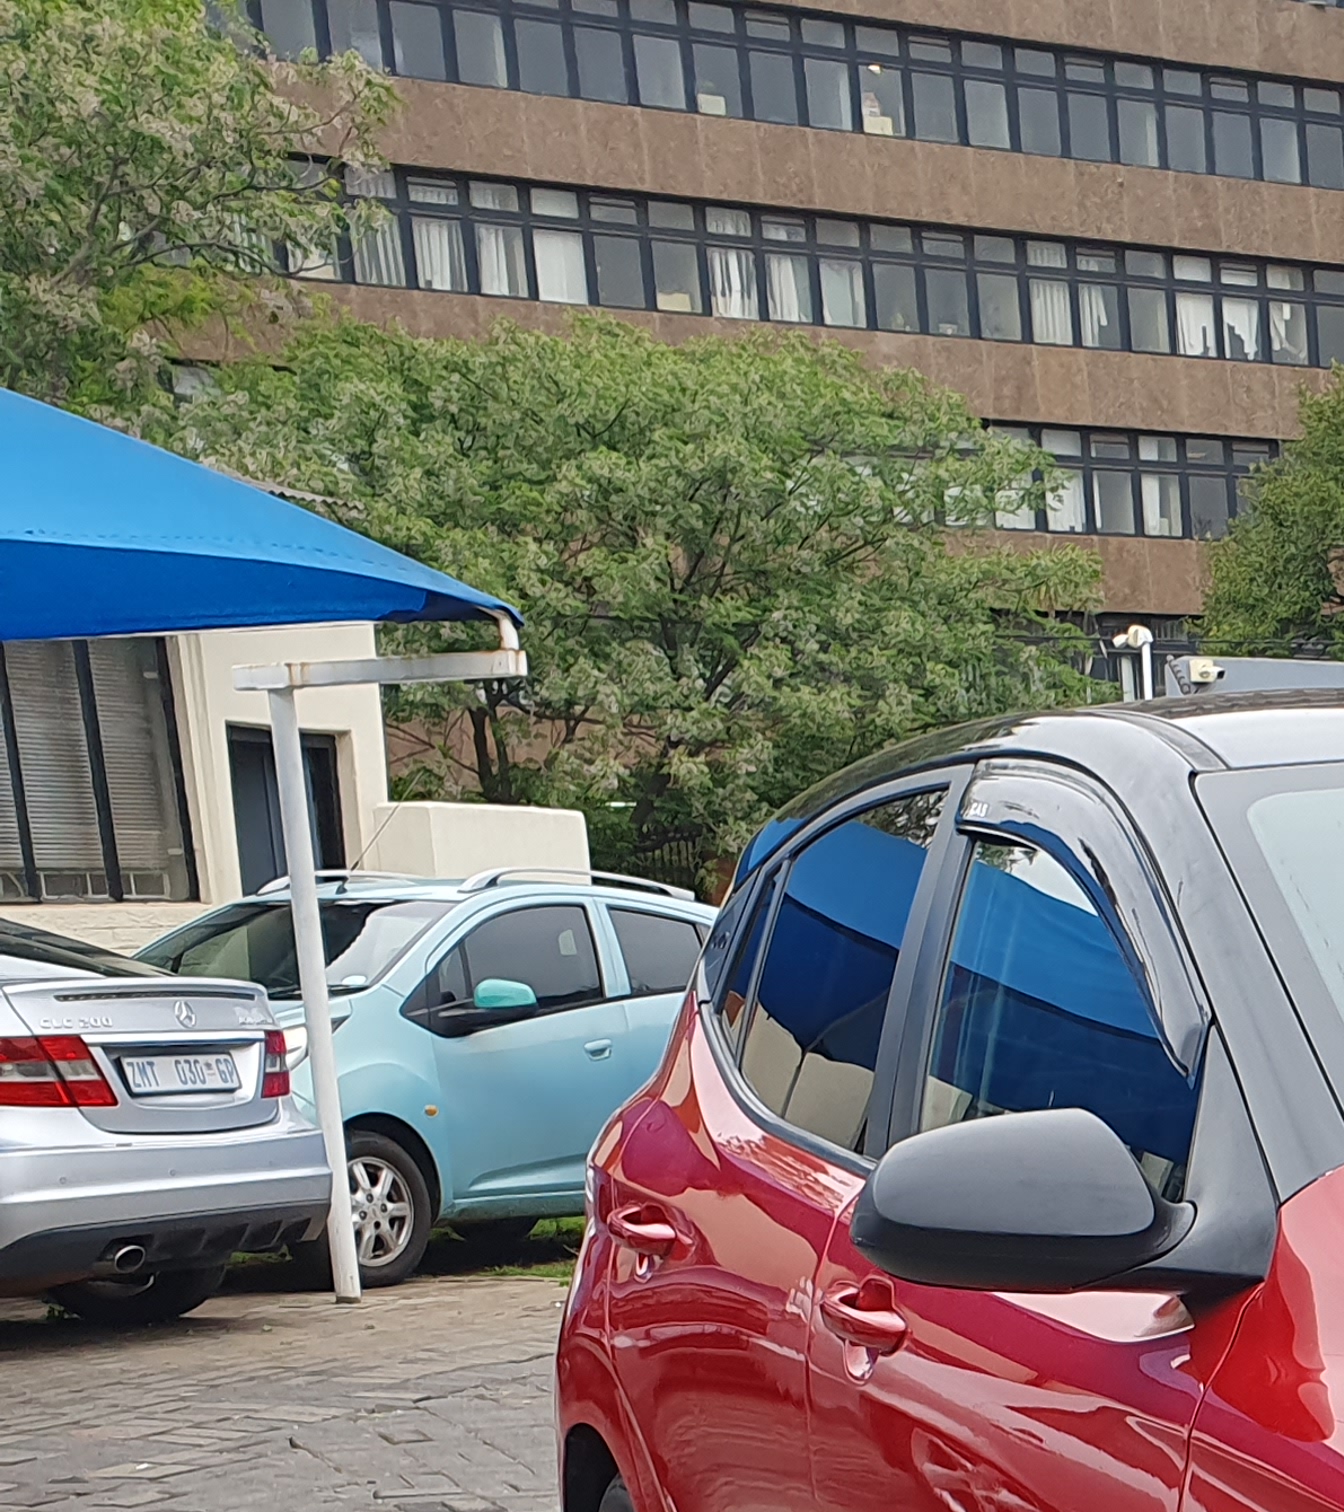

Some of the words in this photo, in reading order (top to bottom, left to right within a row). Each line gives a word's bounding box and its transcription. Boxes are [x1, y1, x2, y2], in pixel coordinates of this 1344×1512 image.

[39, 1016, 74, 1030] CLC
[78, 1015, 114, 1029] 200
[174, 1058, 207, 1086] 030
[214, 1057, 235, 1084] GP
